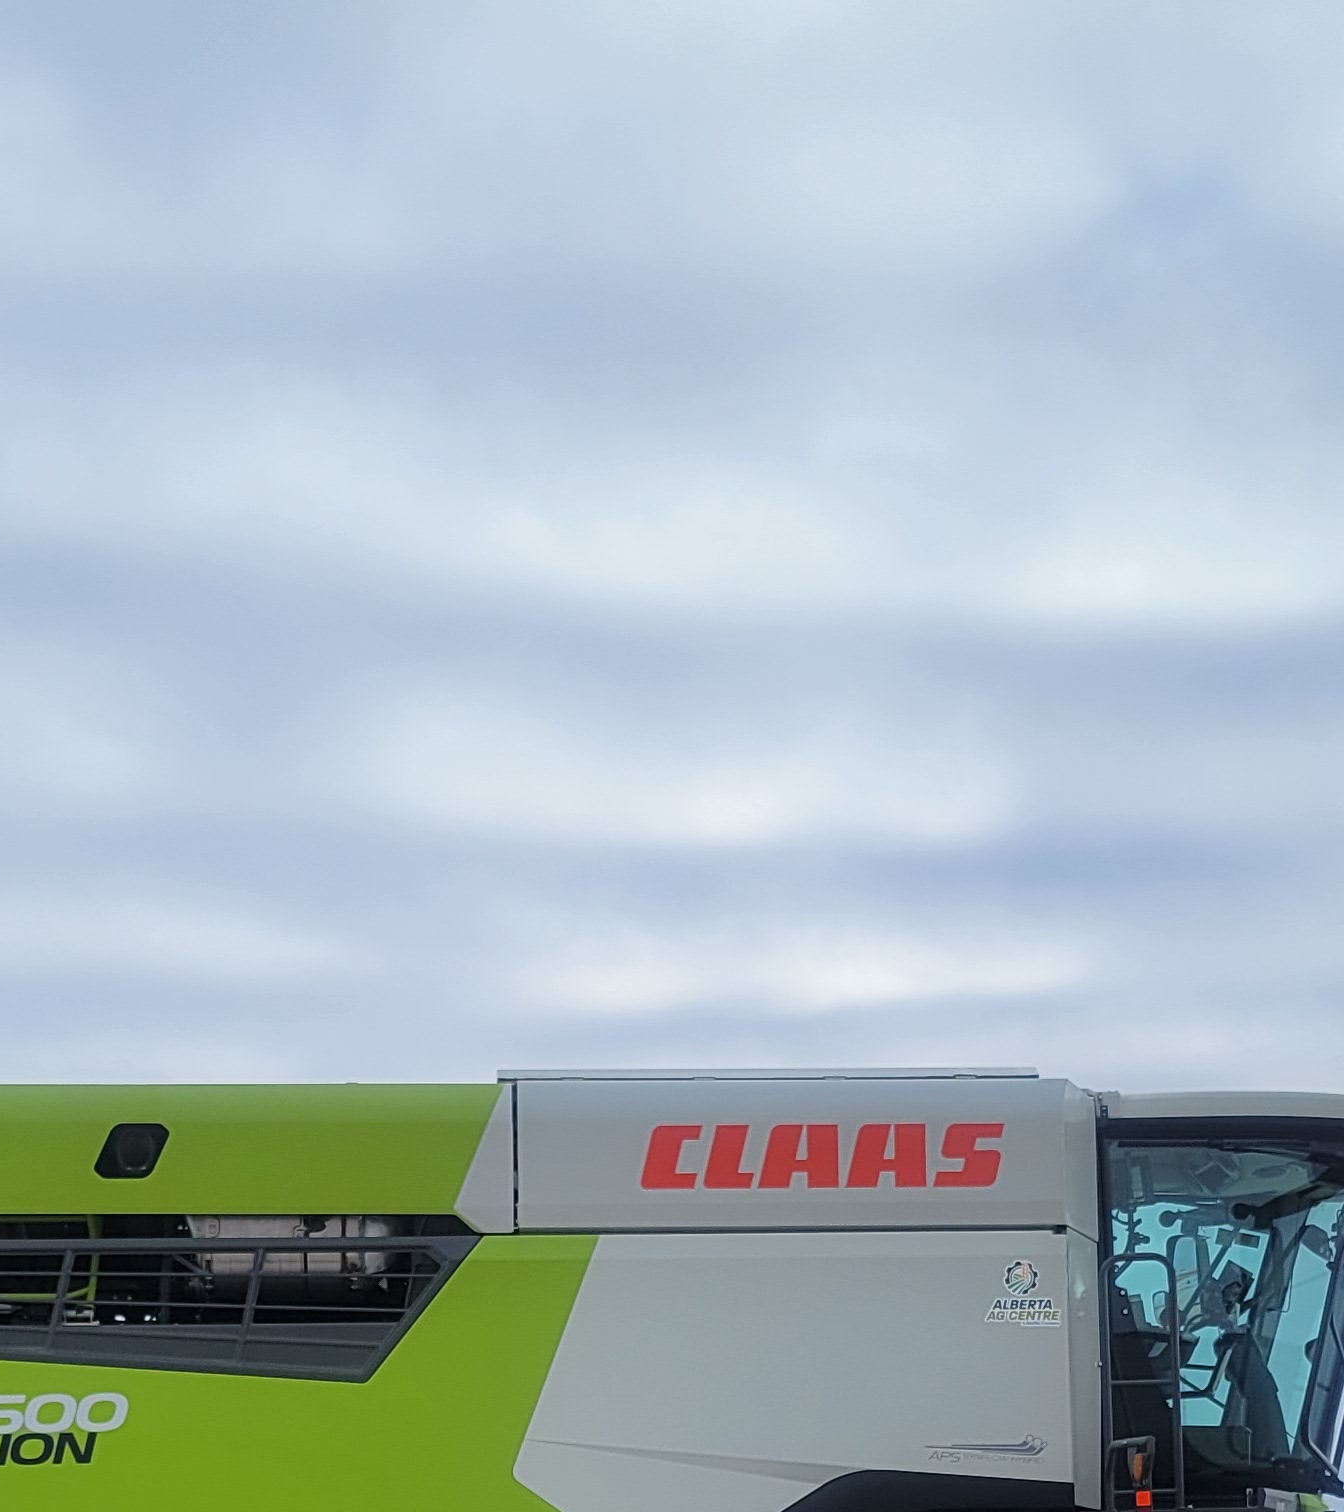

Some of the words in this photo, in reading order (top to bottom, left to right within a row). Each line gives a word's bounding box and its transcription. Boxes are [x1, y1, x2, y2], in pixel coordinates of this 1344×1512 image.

[640, 1123, 1005, 1190] CLAAS
[992, 1299, 1053, 1310] ALBERTA
[985, 1310, 1006, 1321] AG
[1009, 1310, 1060, 1321] CENTRE
[928, 1451, 961, 1463] APS
